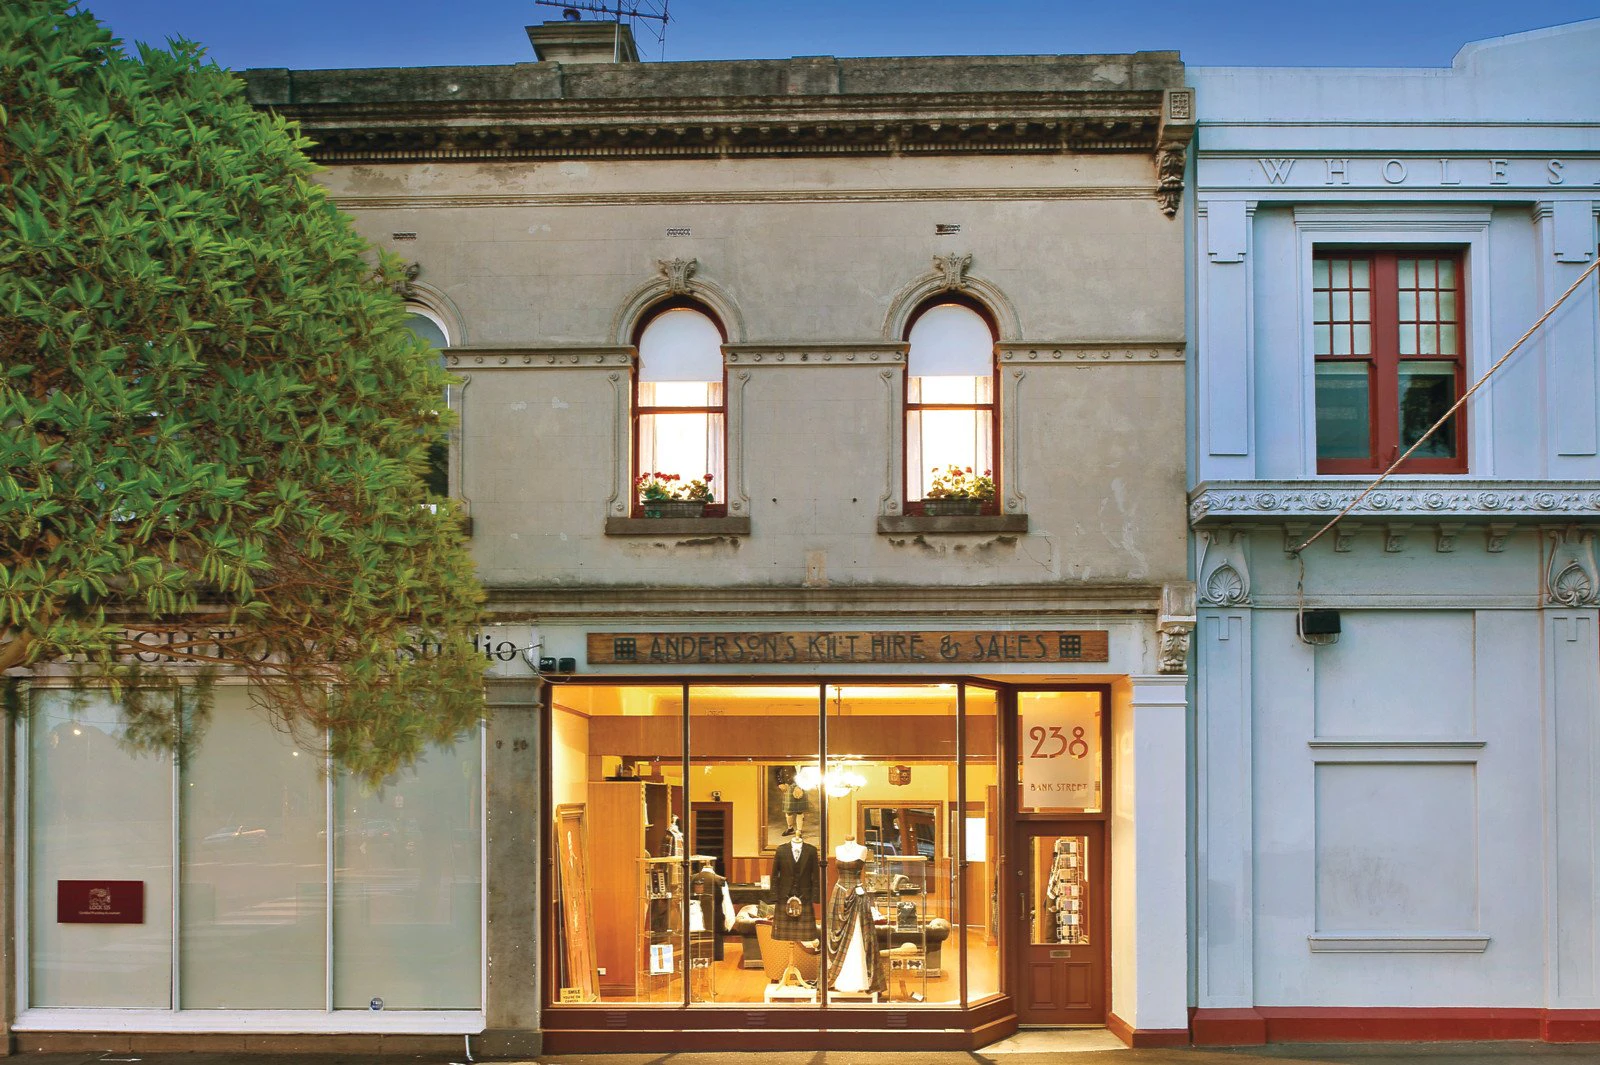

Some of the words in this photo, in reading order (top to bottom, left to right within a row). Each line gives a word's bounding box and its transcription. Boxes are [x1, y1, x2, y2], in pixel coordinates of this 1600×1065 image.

[1258, 158, 1600, 185] WHOLES
[872, 635, 924, 660] HIRE
[940, 635, 960, 659] &
[975, 634, 1047, 659] SALES
[1029, 726, 1089, 759] 238
[1030, 783, 1053, 792] BANK
[1056, 783, 1088, 792] STREET
